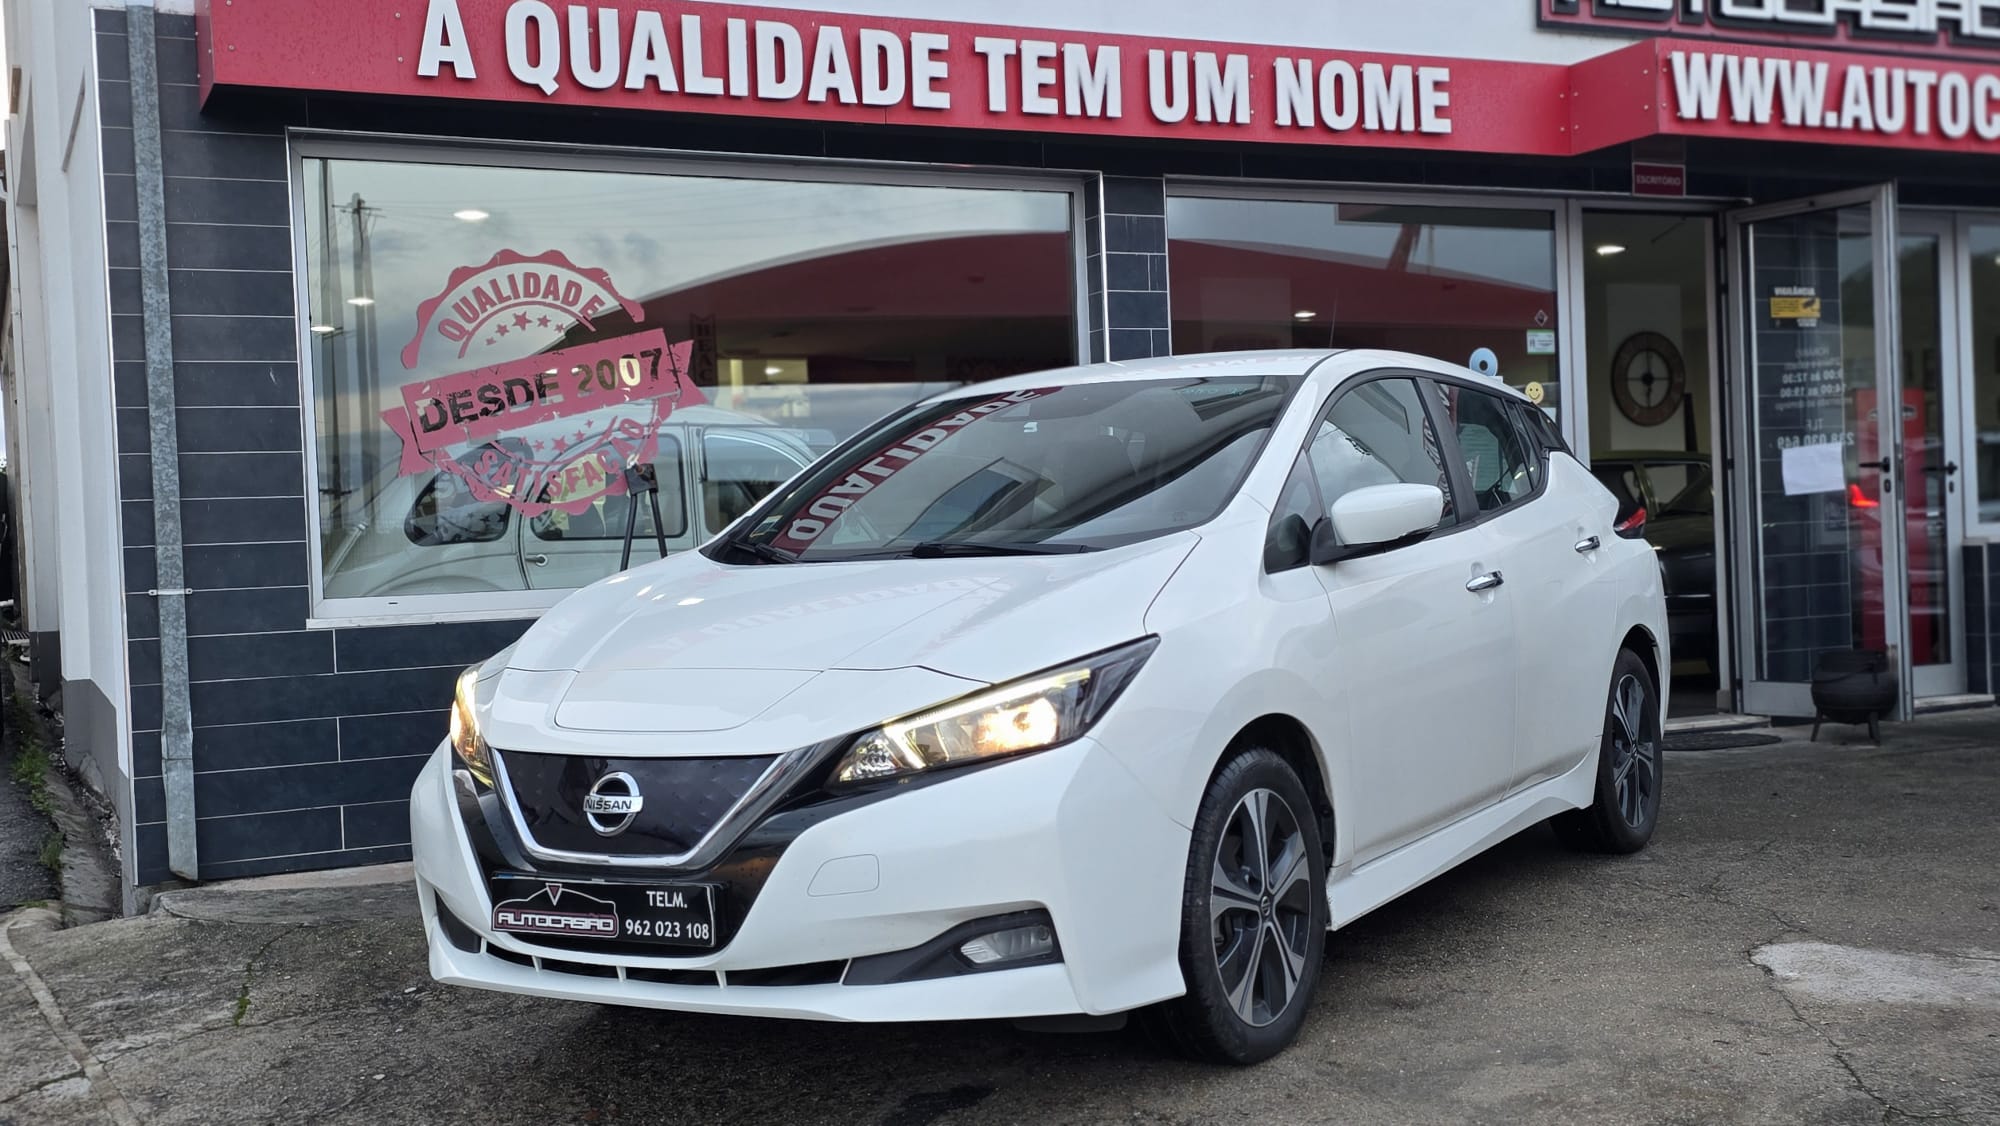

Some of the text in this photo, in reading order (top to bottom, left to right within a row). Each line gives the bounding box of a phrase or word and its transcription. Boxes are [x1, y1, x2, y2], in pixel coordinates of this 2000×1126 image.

[417, 0, 1452, 133] A QUALIDADE TEM UM NOME
[1671, 51, 2000, 139] WWW.AUTOC
[438, 272, 606, 342] QUALIDADE
[415, 348, 663, 433] DESDE 2007
[585, 799, 632, 810] NISSAN
[625, 918, 709, 940] 962 023 108
[646, 891, 688, 908] TELM.
